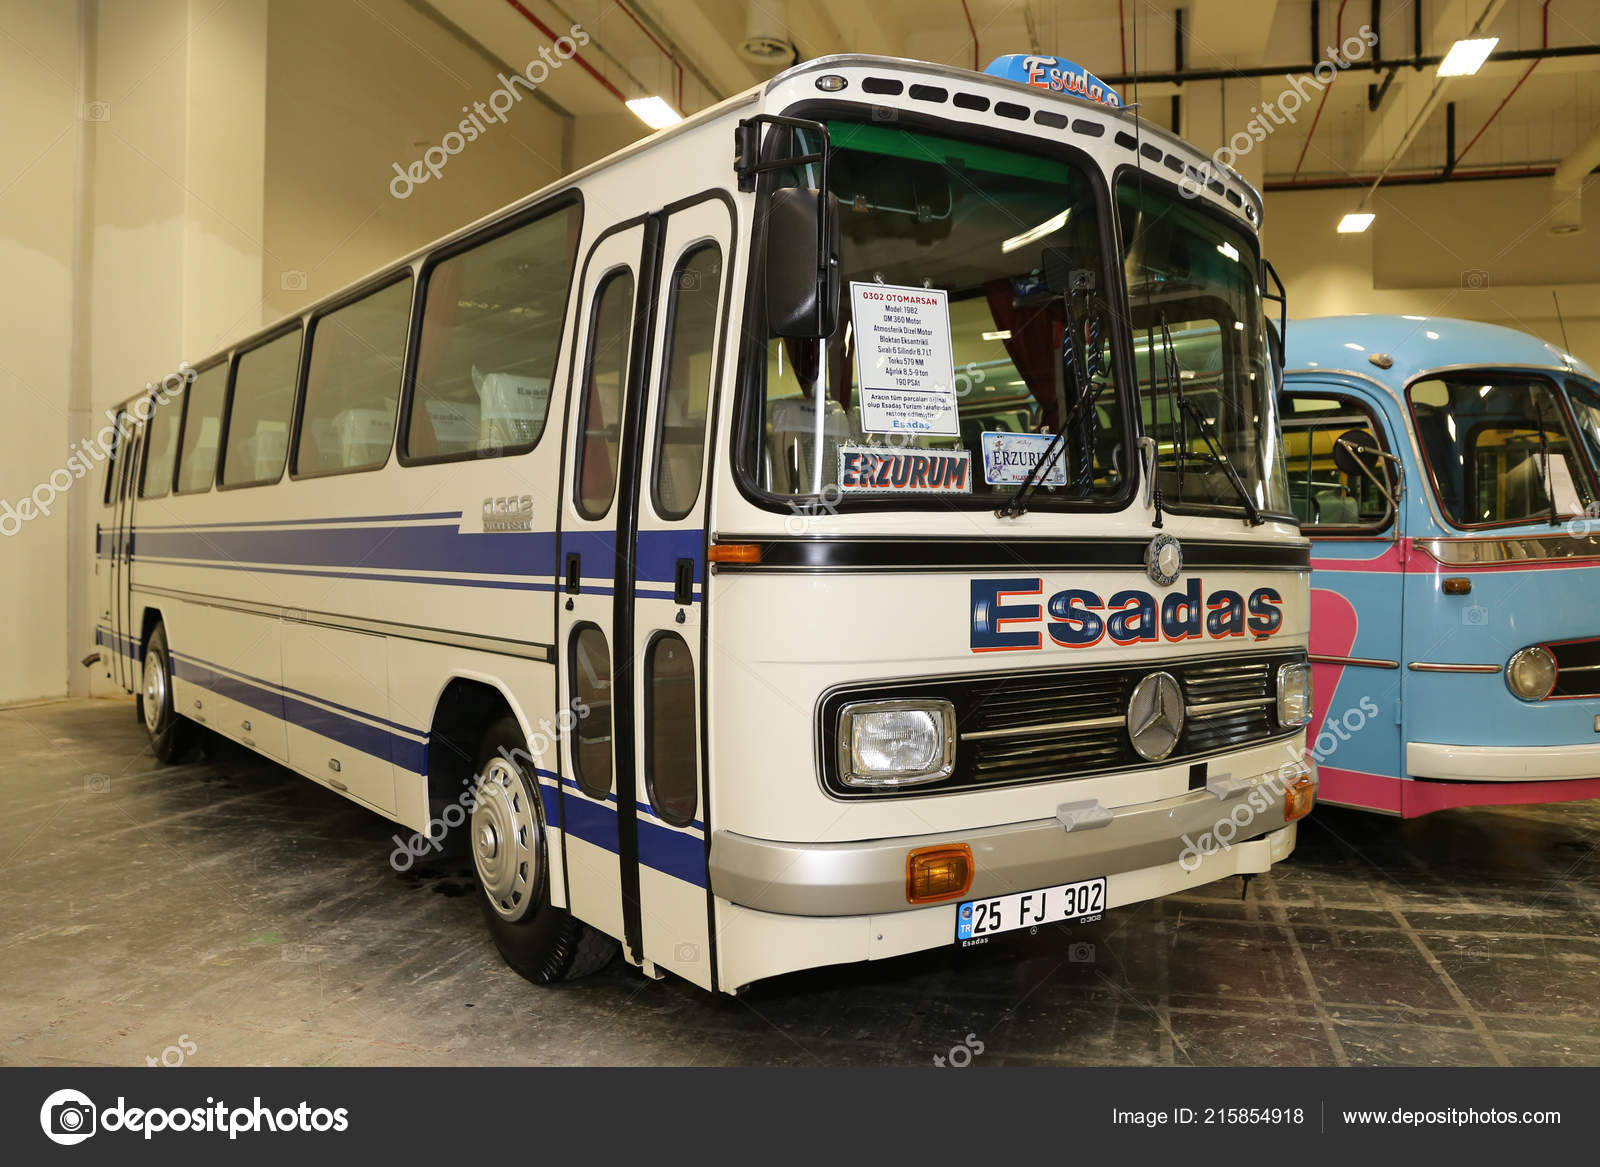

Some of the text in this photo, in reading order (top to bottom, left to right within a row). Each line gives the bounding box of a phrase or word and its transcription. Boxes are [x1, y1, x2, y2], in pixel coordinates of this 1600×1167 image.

[886, 293, 938, 305] OTOMARSAN
[885, 305, 918, 314] Model: 1982
[906, 317, 922, 325] Motor
[873, 325, 933, 336] Atmosferik Dizel Motor
[879, 335, 929, 345] Bloktan Eksantrikli
[919, 369, 928, 377] ton
[896, 378, 906, 386] 190
[843, 452, 969, 490] ERZURUM
[970, 578, 1284, 653] Esadaş
[974, 883, 1103, 934] 25 FJ 302
[960, 924, 971, 934] TR
